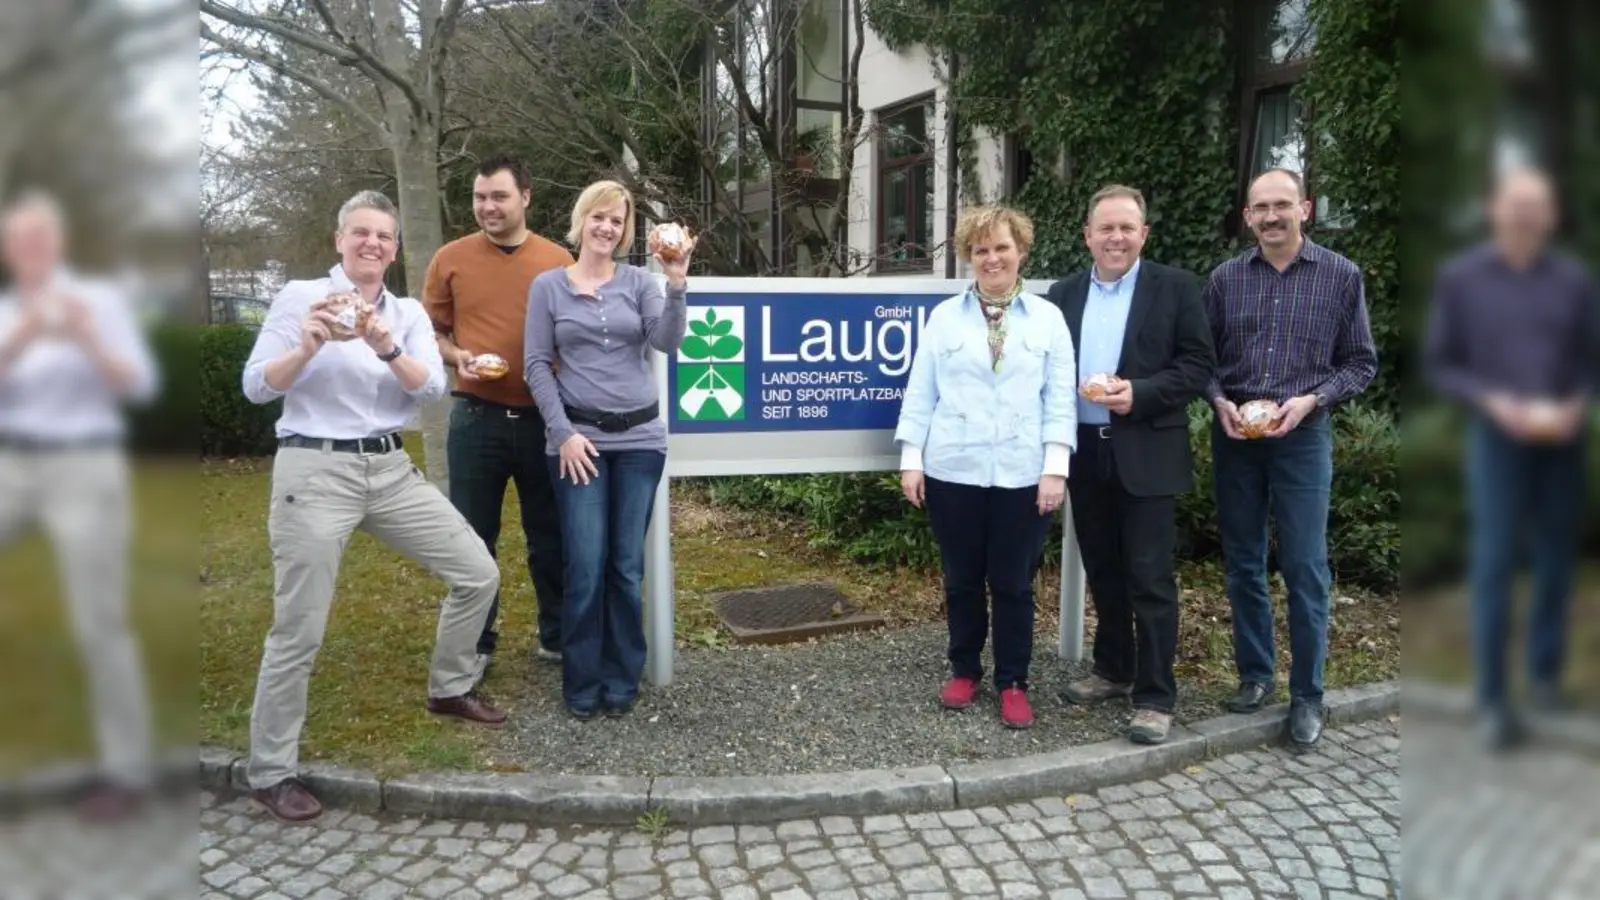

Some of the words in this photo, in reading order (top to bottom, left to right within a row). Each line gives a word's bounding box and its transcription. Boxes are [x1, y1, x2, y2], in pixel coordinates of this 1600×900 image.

[875, 305, 912, 318] GmbH
[762, 371, 868, 385] LANDSCHAFTS-
[762, 389, 792, 402] UND
[797, 387, 906, 401] SPORTPLATZBA
[762, 406, 792, 419] SEIT
[797, 406, 828, 418] 1896
